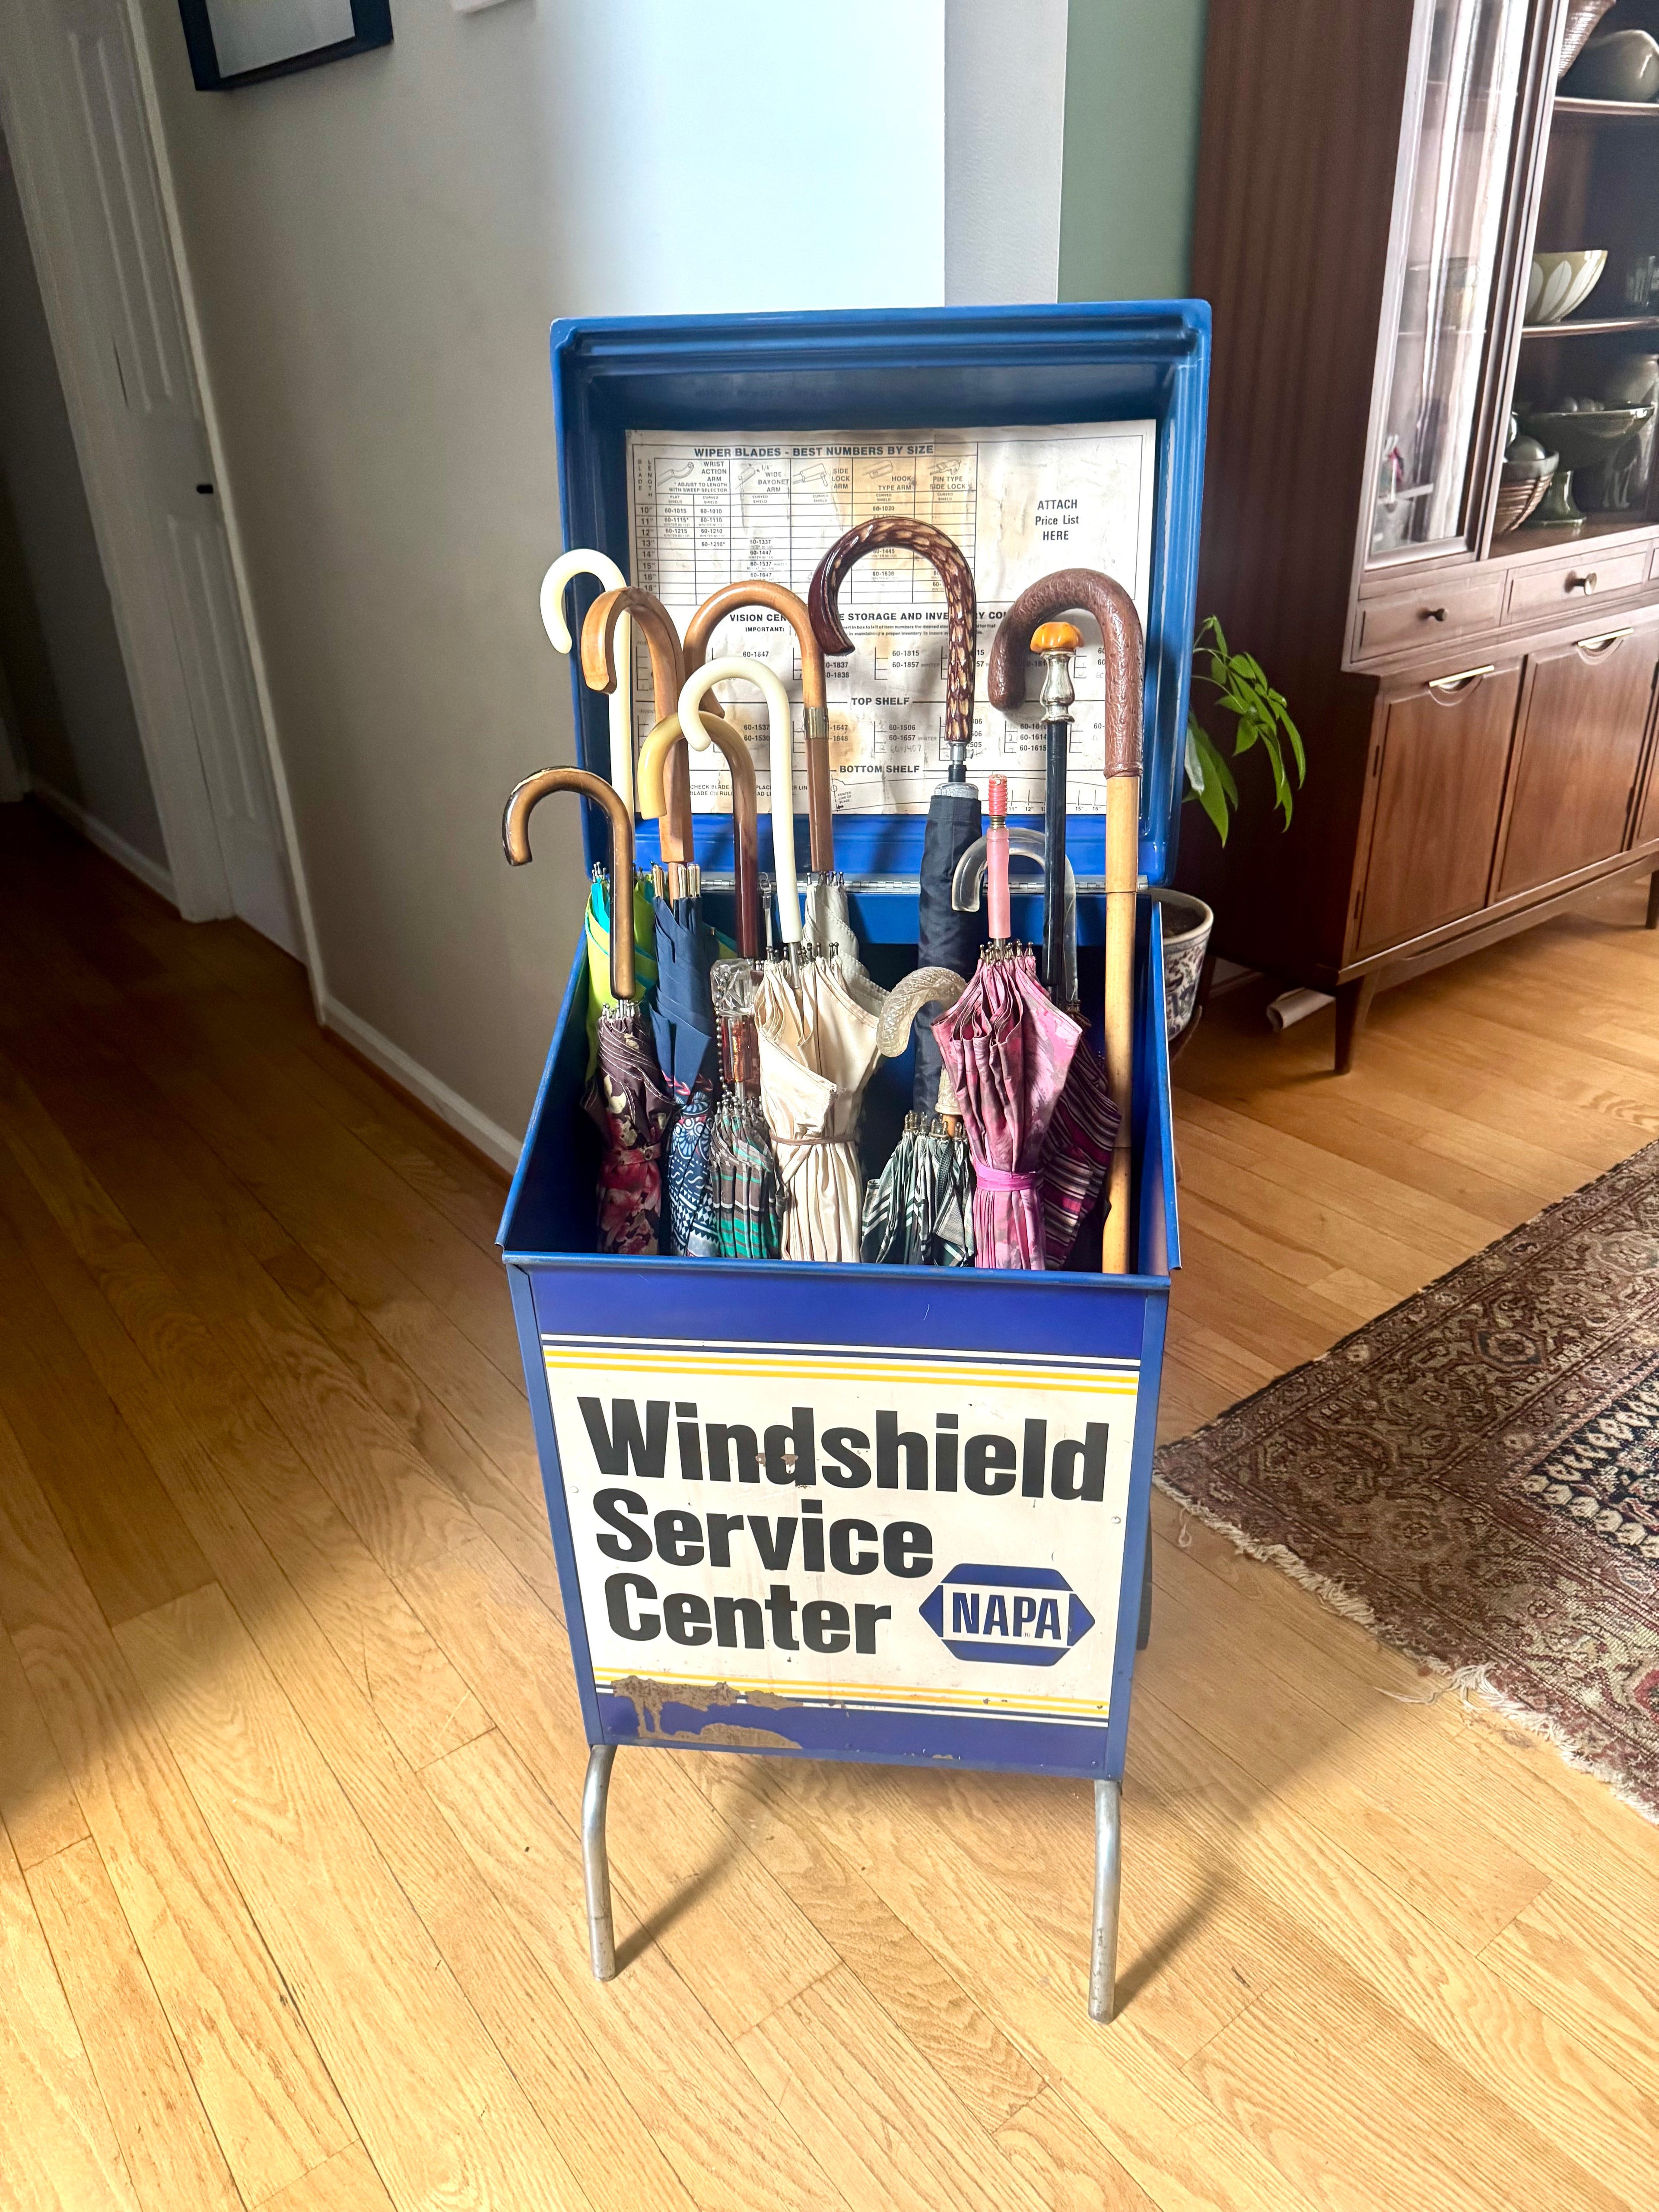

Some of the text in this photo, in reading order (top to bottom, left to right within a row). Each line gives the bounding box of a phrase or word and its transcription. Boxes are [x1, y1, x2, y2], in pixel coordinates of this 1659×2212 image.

[694, 448, 731, 457] WIPER
[735, 448, 781, 457] BLADES
[793, 448, 822, 456] BEST
[826, 446, 883, 456] NUMBERS
[888, 446, 903, 455] BY
[907, 445, 933, 454] SIZE
[1037, 499, 1077, 510] ATTACH
[1035, 515, 1079, 525] Price List
[1043, 531, 1068, 540] HERE
[577, 1396, 1109, 1502] Windshield
[592, 1488, 933, 1579] Service
[604, 1573, 892, 1654] Center
[952, 1592, 1062, 1640] NAPA
